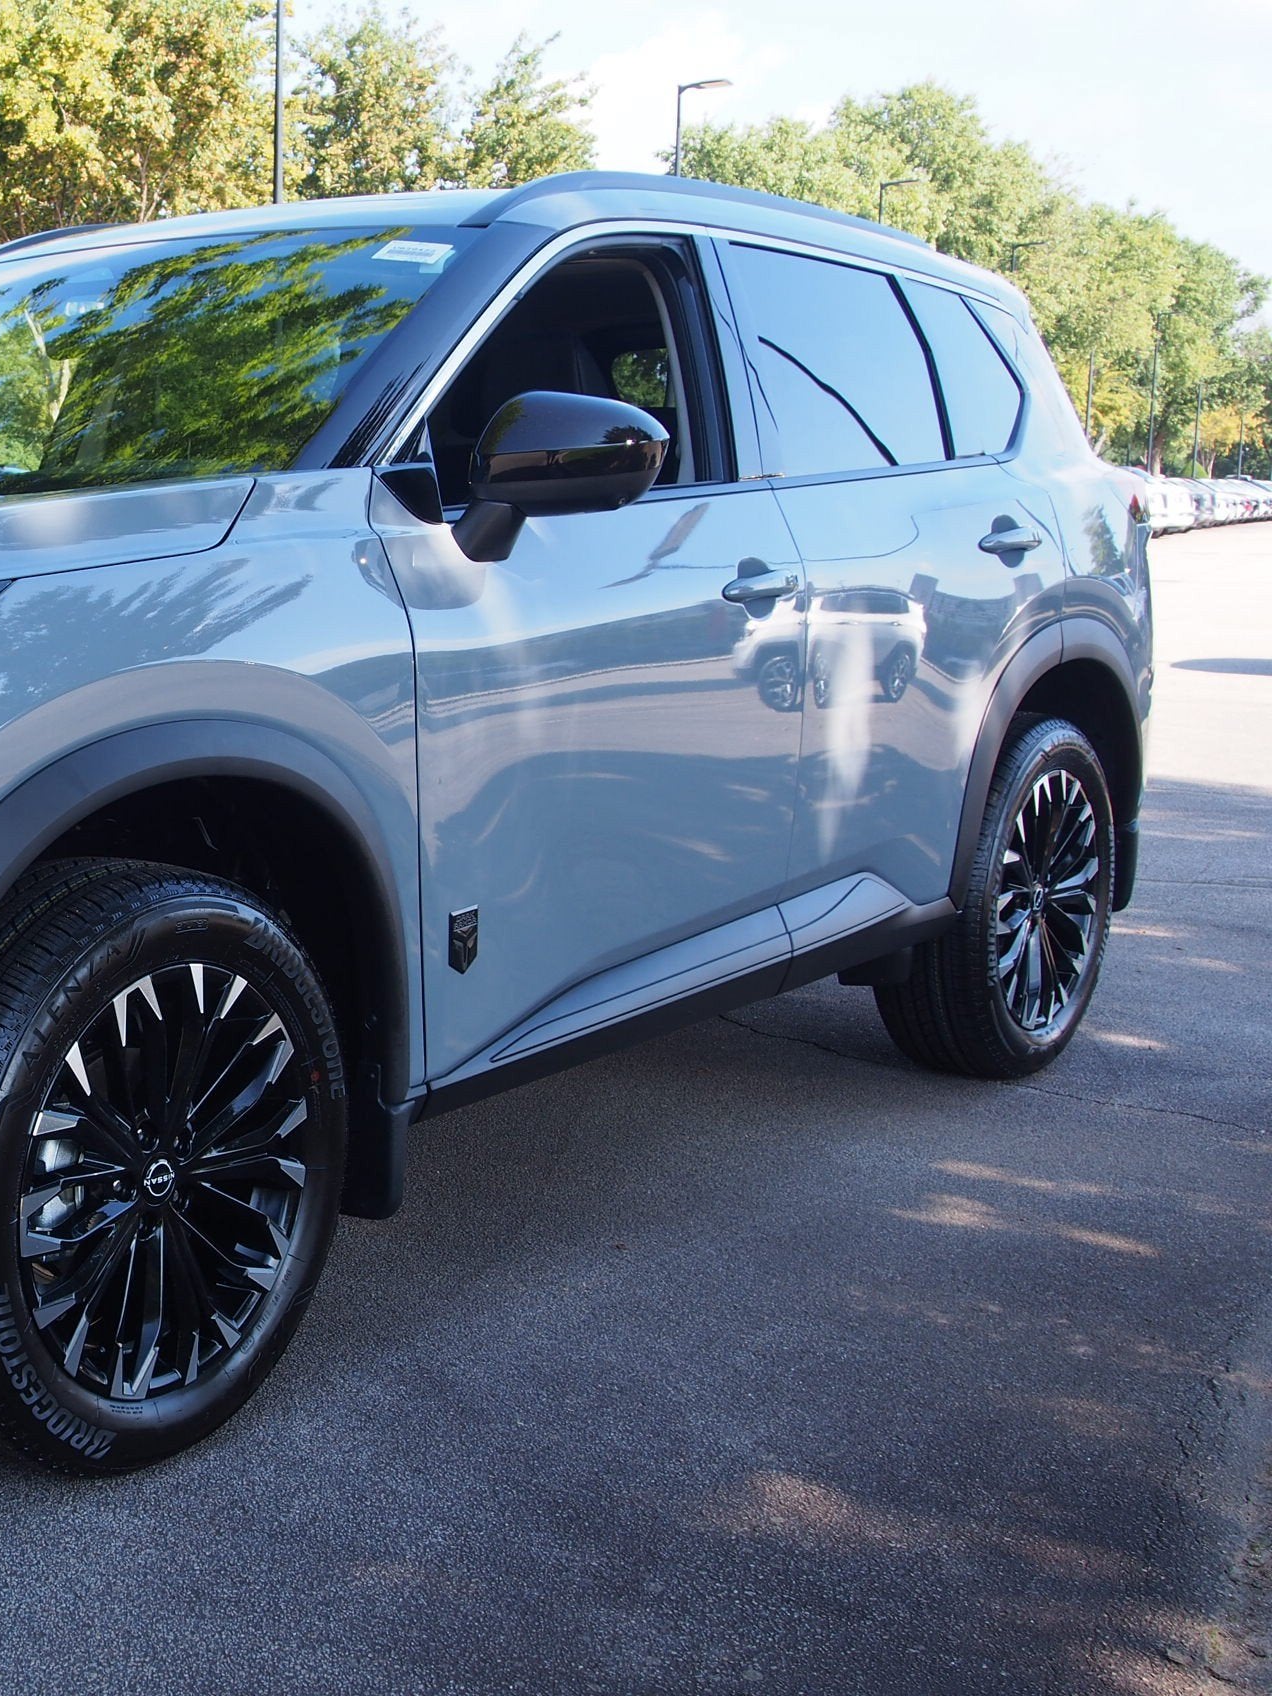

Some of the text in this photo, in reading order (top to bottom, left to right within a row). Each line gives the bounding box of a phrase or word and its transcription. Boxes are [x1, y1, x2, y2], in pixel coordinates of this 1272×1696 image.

[21, 940, 122, 1070] ALENZA
[243, 916, 347, 1100] BRIDGESTONE
[143, 1171, 175, 1187] NISSAN
